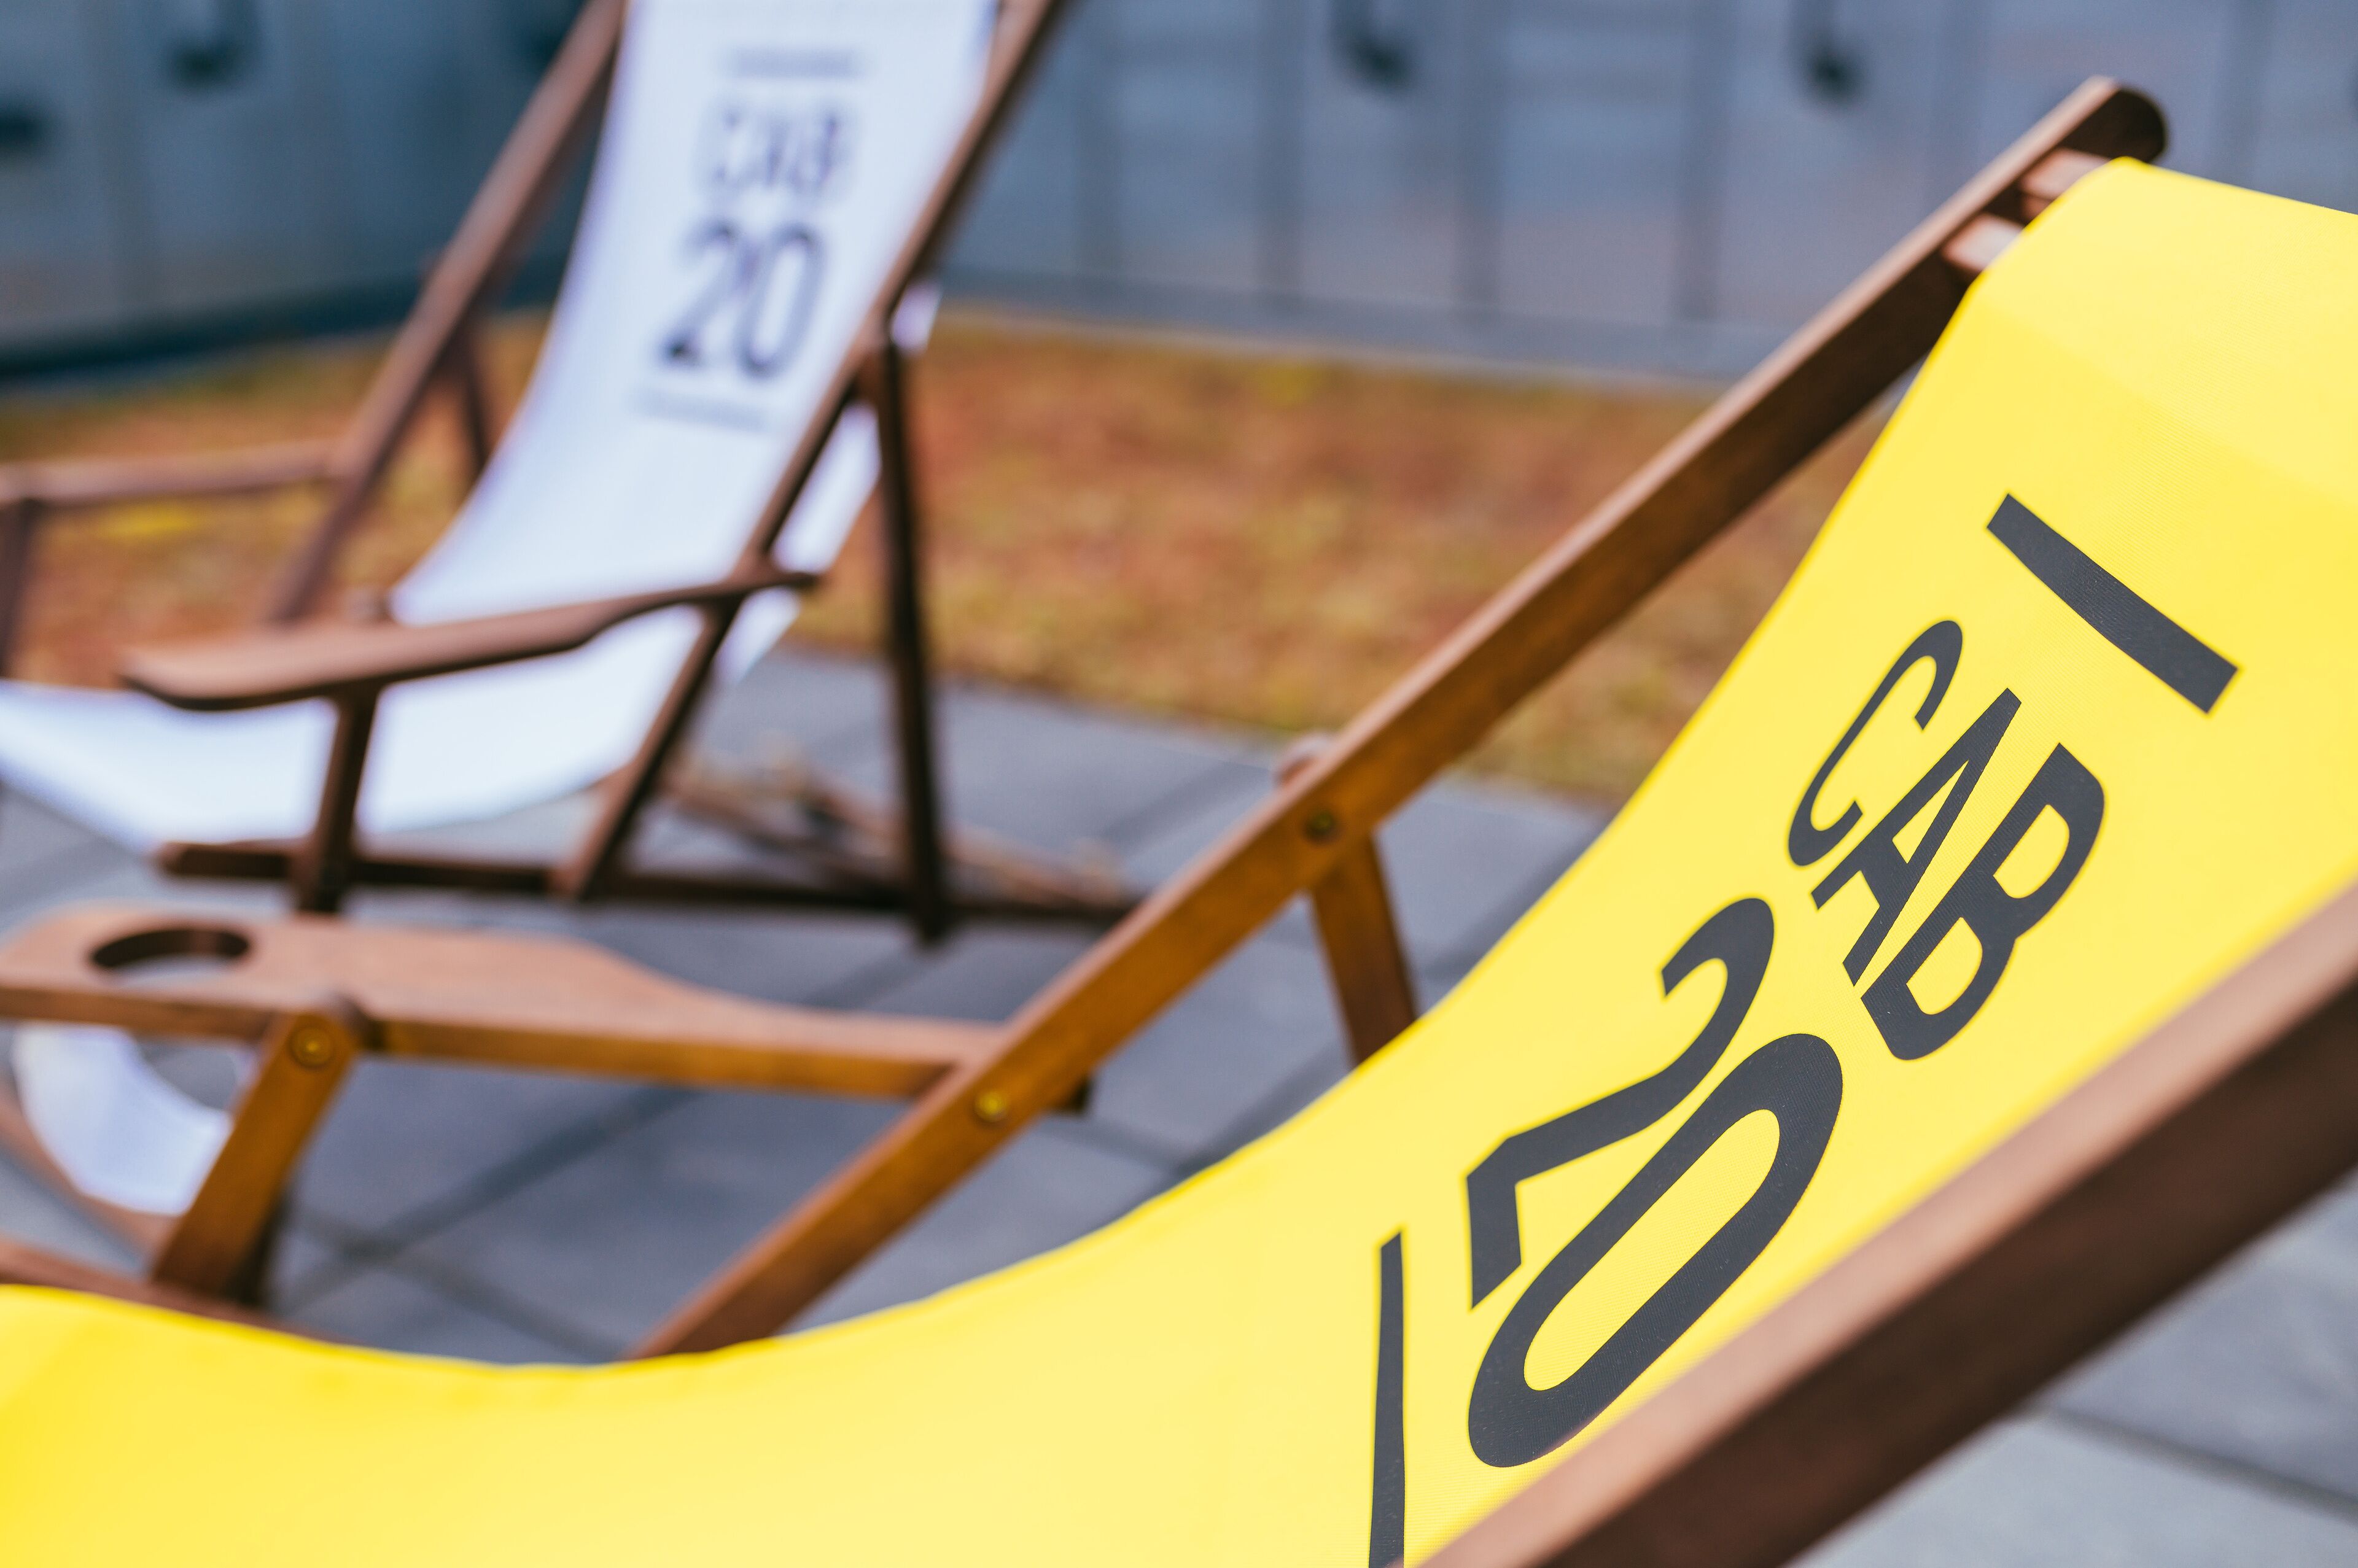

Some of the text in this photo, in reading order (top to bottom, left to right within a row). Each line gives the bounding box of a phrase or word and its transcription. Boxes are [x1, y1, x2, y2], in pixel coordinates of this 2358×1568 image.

[657, 216, 824, 379] 20
[697, 100, 855, 200] CAB
[1788, 619, 2105, 1060] CAB
[1466, 898, 1843, 1468] 20
